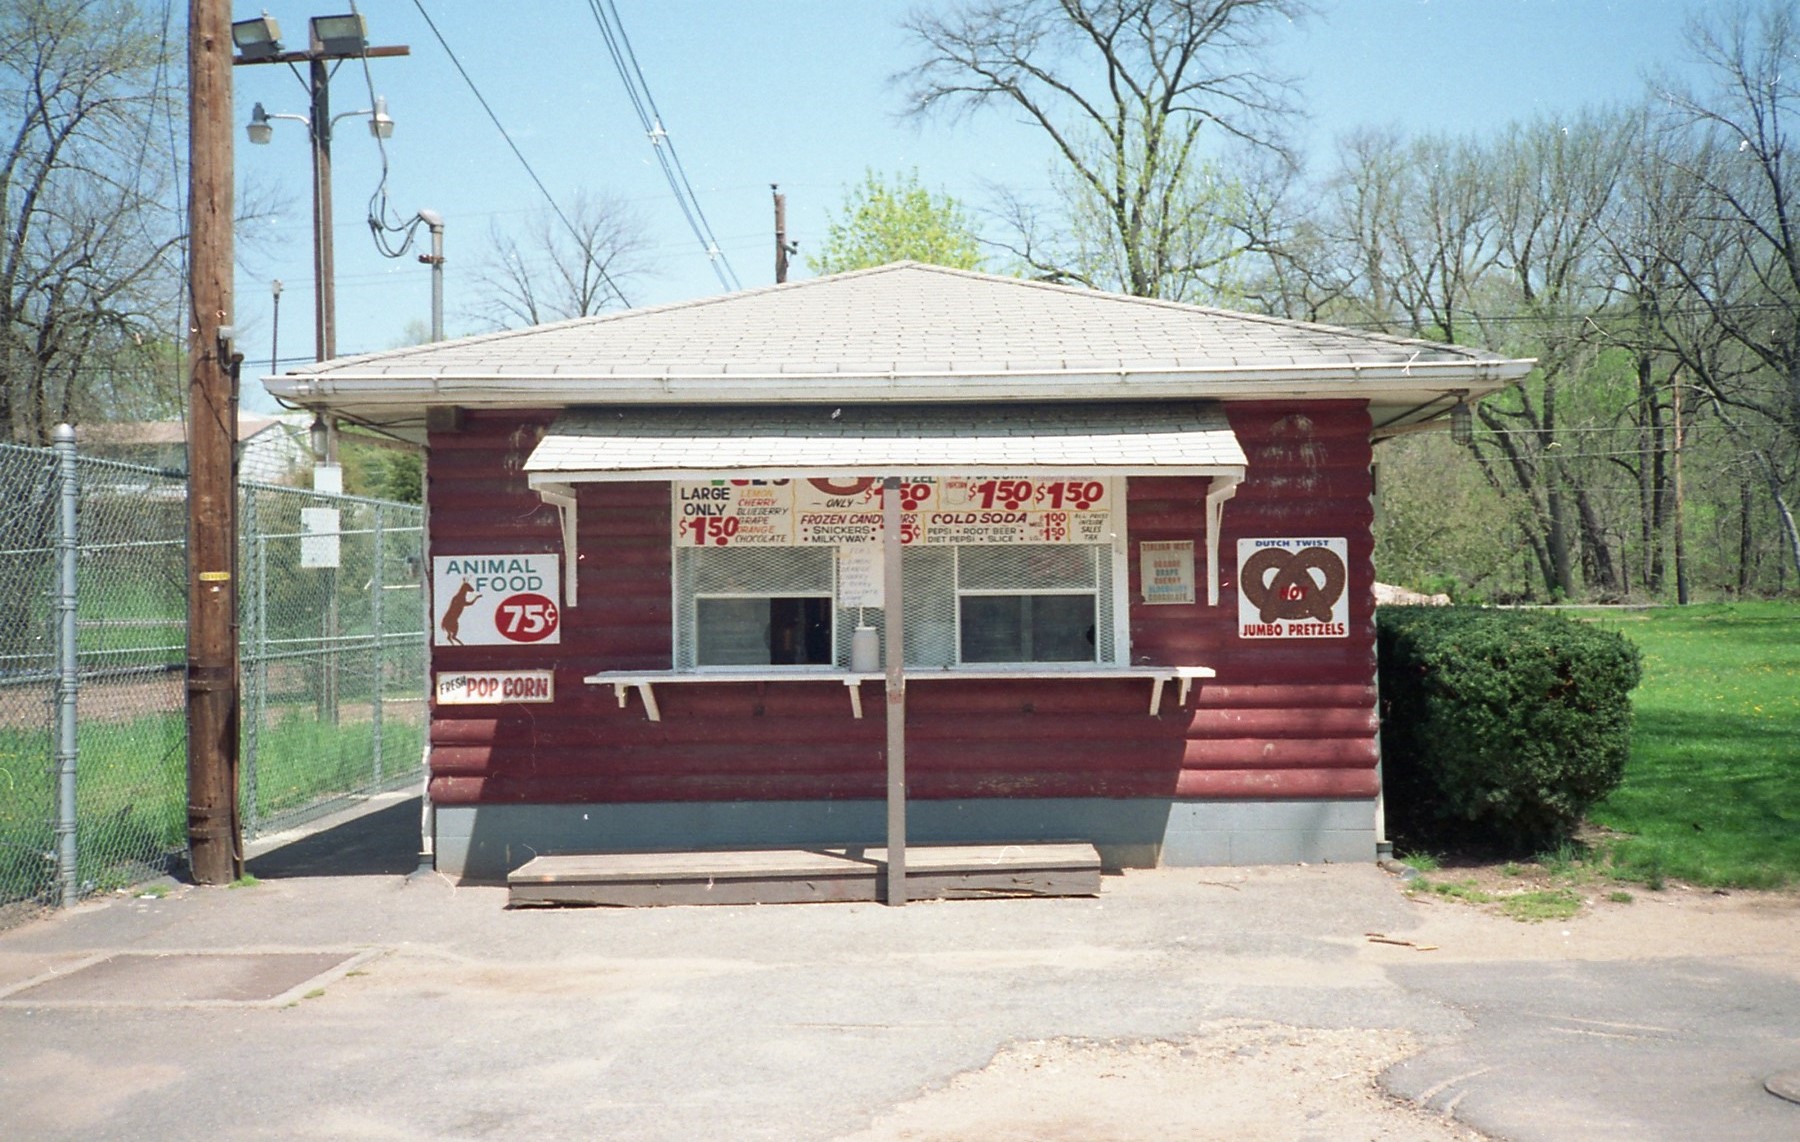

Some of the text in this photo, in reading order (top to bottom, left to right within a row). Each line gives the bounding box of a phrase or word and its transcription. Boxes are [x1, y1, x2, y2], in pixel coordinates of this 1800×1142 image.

[681, 487, 731, 500] LARGE
[740, 489, 774, 497] LEMON
[738, 499, 778, 507] CHERRY
[826, 499, 854, 508] ONLY
[684, 503, 727, 516] ONLY
[736, 507, 789, 515] BLUEBERRY
[800, 514, 847, 525] FROZEN
[931, 512, 1027, 524] COLD SODA
[737, 525, 776, 533] ORANGE
[813, 526, 870, 534] SNICKERS
[735, 534, 787, 543] CHOCOLATE
[812, 535, 868, 543] MILKYWAY
[446, 559, 536, 574] ANIMAL
[476, 576, 543, 592] FOOD
[1279, 586, 1309, 600] HOT
[503, 603, 556, 633] 75¢
[1243, 623, 1345, 636] JUMBO PRETZELS
[440, 675, 549, 698] FRESH POP CORN
